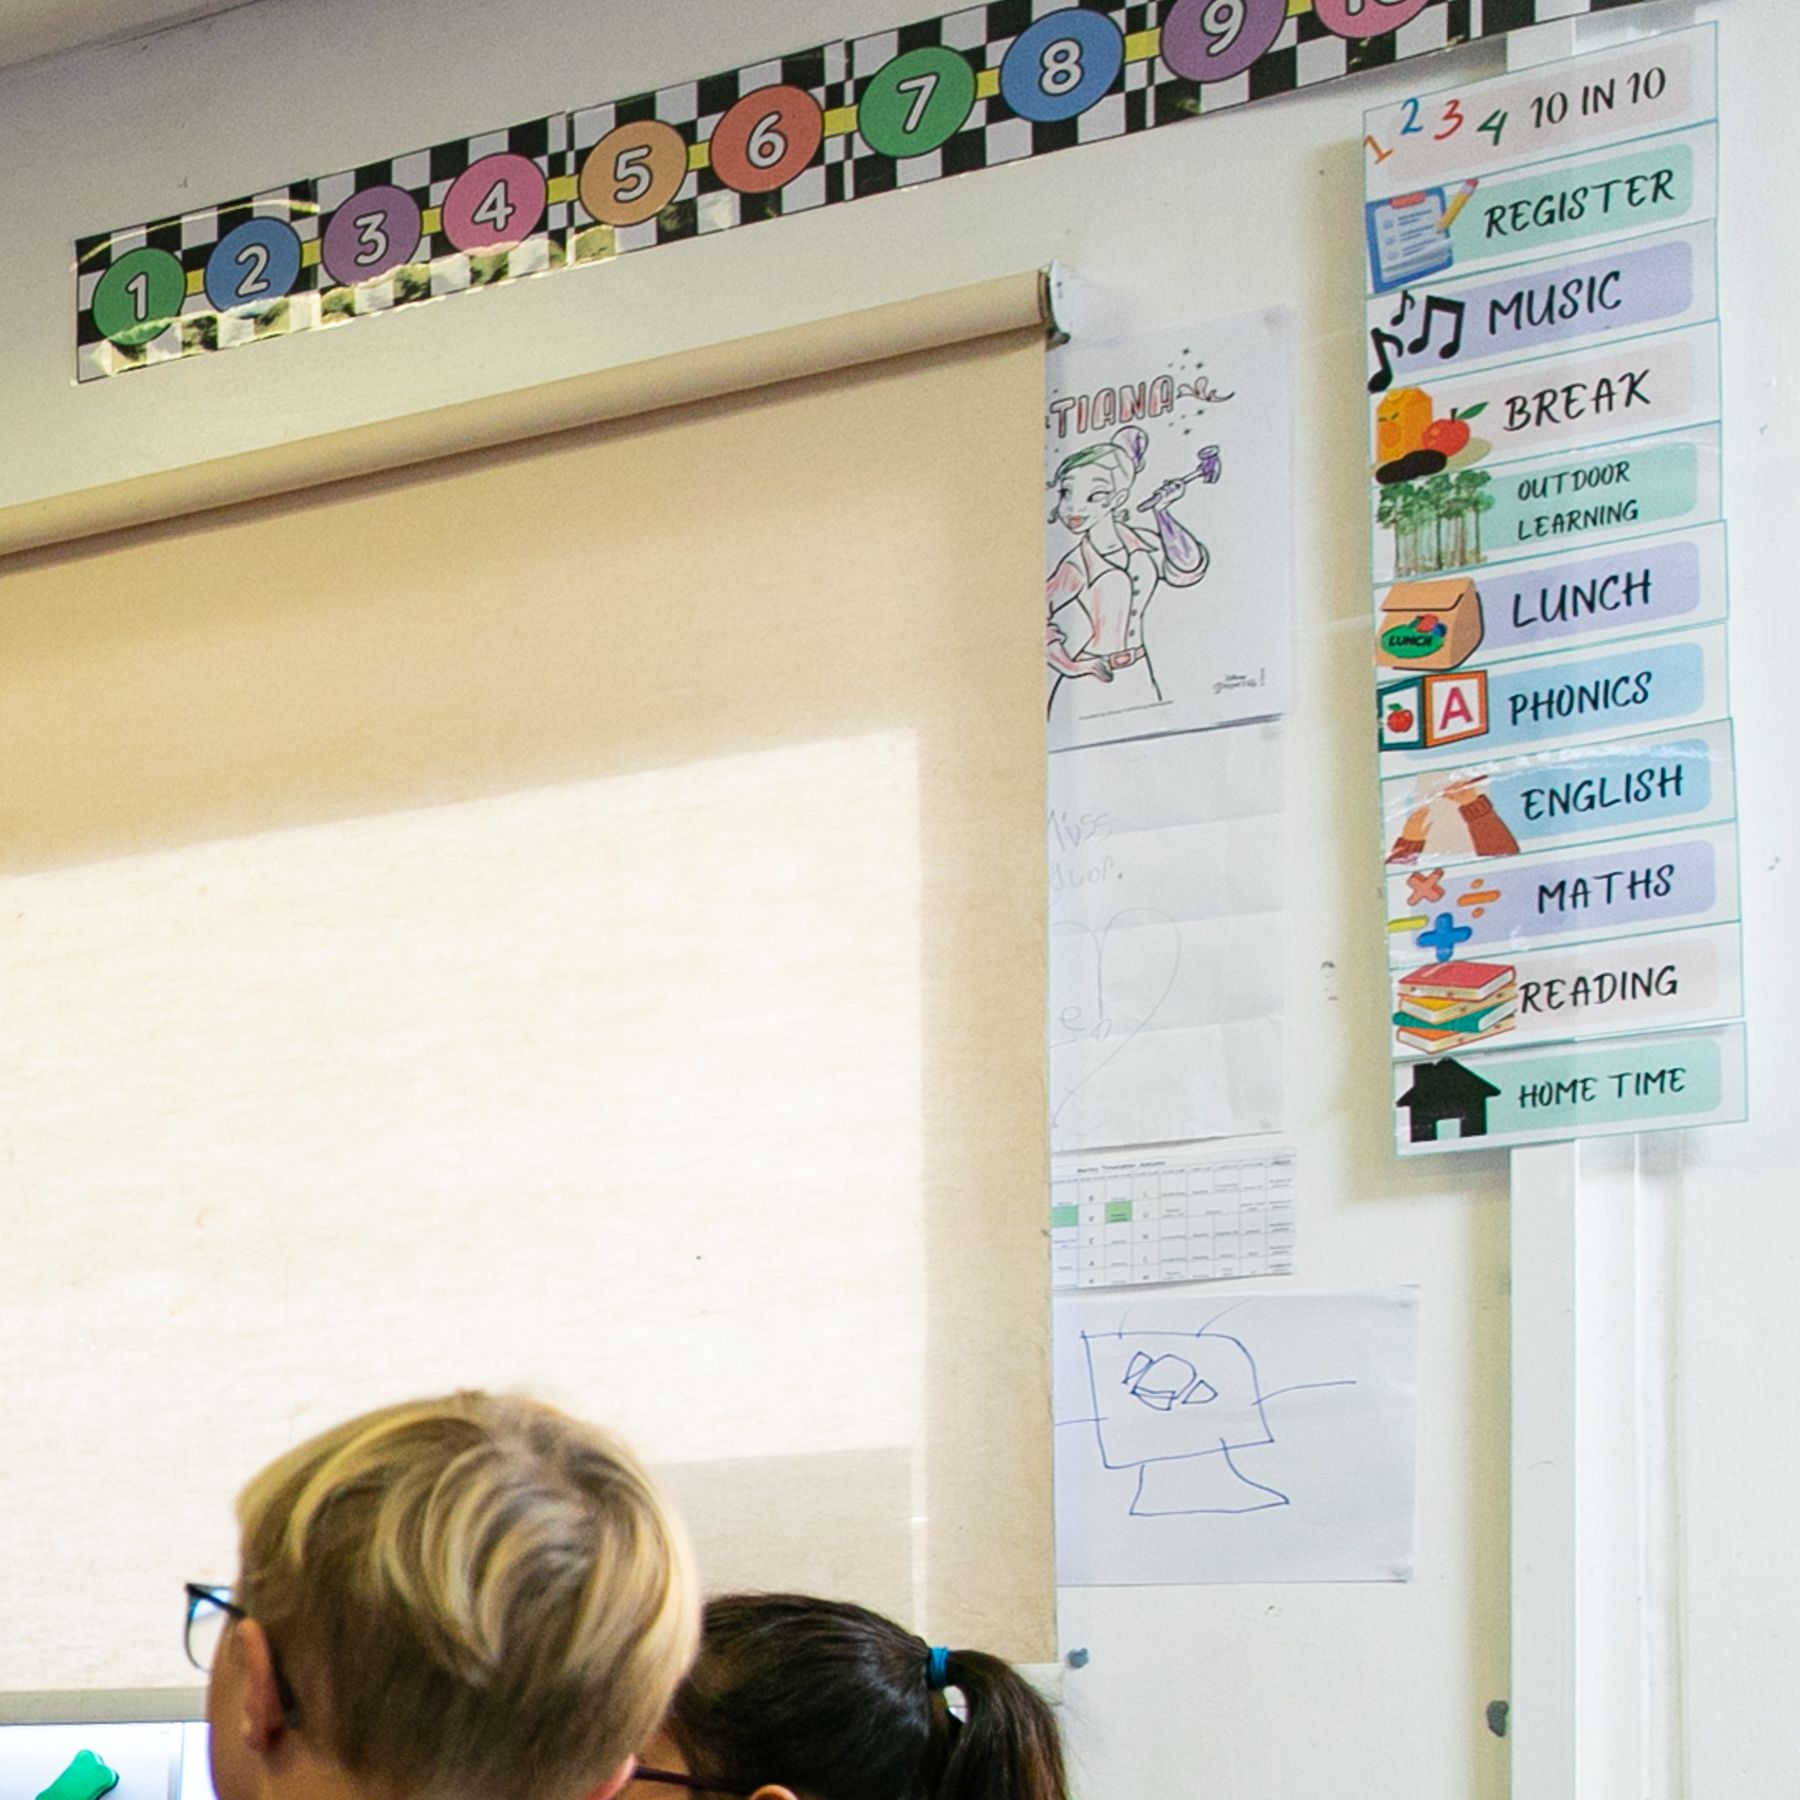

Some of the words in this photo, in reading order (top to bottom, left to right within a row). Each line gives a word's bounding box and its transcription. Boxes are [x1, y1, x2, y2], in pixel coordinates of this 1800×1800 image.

[1201, 0, 1247, 56] 9
[1039, 38, 1084, 97] 8
[897, 72, 940, 134] 7
[1531, 91, 1568, 128] 10
[1581, 77, 1616, 116] IN
[1626, 66, 1666, 104] 10
[745, 111, 788, 170] 6
[613, 145, 653, 203] 5
[472, 179, 516, 231] 4
[1484, 168, 1675, 239] REGISTER
[353, 211, 389, 267] 3
[126, 271, 150, 321] 1
[234, 244, 271, 297] 2
[1489, 269, 1622, 335] MUSIC
[1050, 374, 1174, 439] TIANA
[1502, 369, 1651, 432] BREAK
[1518, 460, 1631, 501] OUTDOOR
[1517, 499, 1640, 541] LEARNING
[1512, 568, 1652, 628] LUNCH
[1439, 686, 1473, 731] A
[1508, 671, 1653, 726] PHONICS
[1521, 764, 1683, 821] ENGLISH
[1537, 864, 1676, 915] MATHS
[1518, 965, 1679, 1014] READING
[1518, 1076, 1597, 1110] HOME
[1607, 1067, 1687, 1099] TIME
